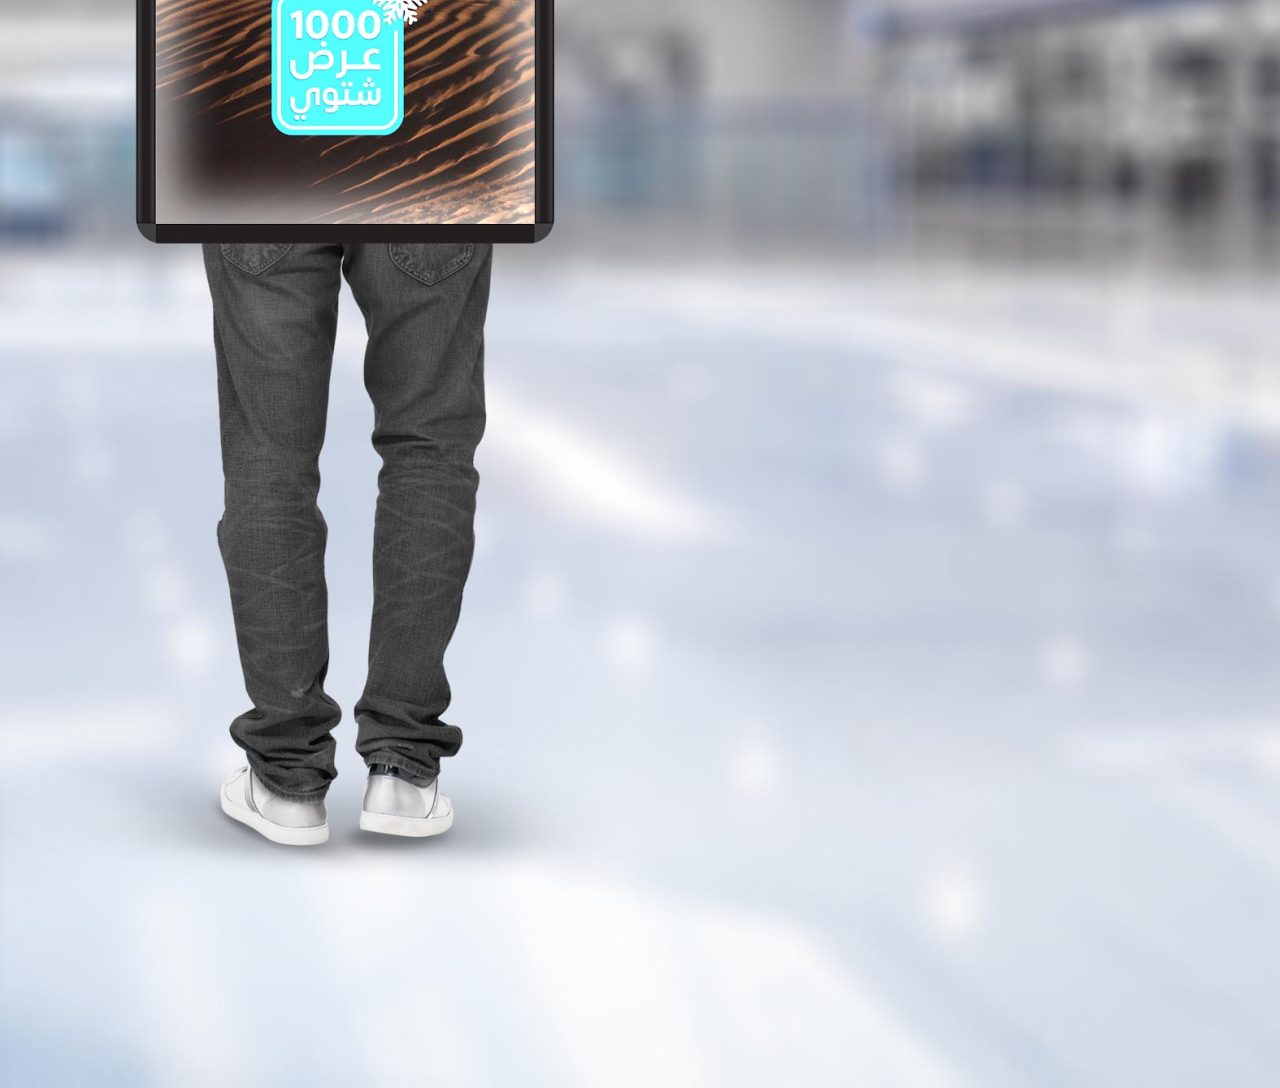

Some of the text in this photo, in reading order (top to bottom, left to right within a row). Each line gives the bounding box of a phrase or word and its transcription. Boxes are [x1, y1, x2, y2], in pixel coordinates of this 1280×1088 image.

[290, 9, 381, 40] 1000
[289, 41, 382, 80] عرض
[289, 77, 382, 122] شتوي
